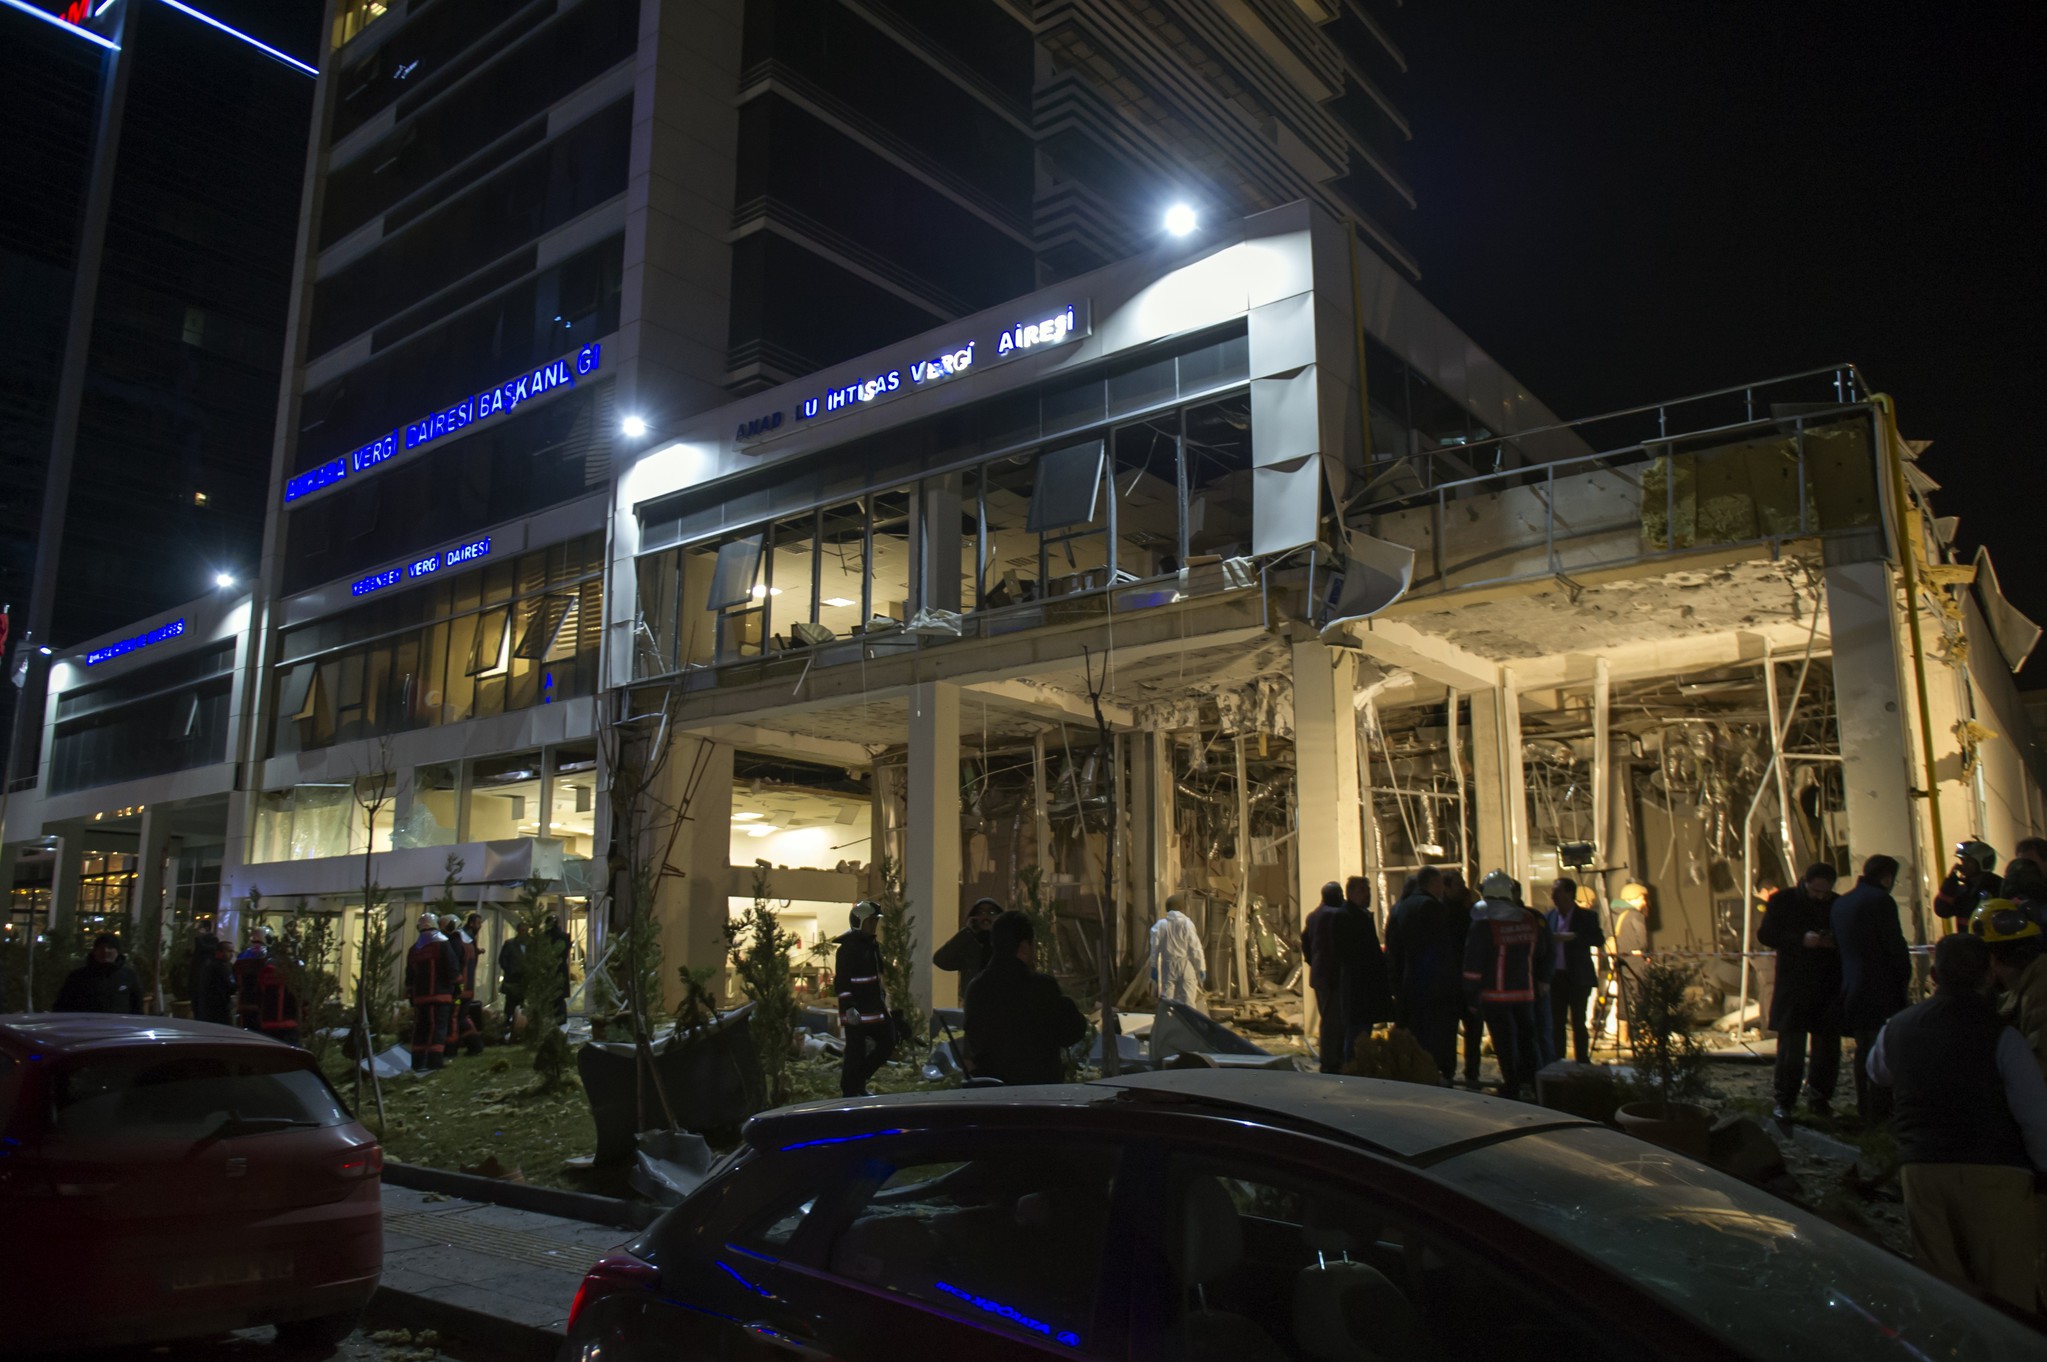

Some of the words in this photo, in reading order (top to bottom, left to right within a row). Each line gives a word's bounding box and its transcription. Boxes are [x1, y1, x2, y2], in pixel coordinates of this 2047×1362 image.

[351, 427, 399, 473] VERGİ
[405, 395, 475, 450] DAİRESİ
[407, 551, 442, 579] VERGİ
[444, 536, 491, 569] DAİRESİ
